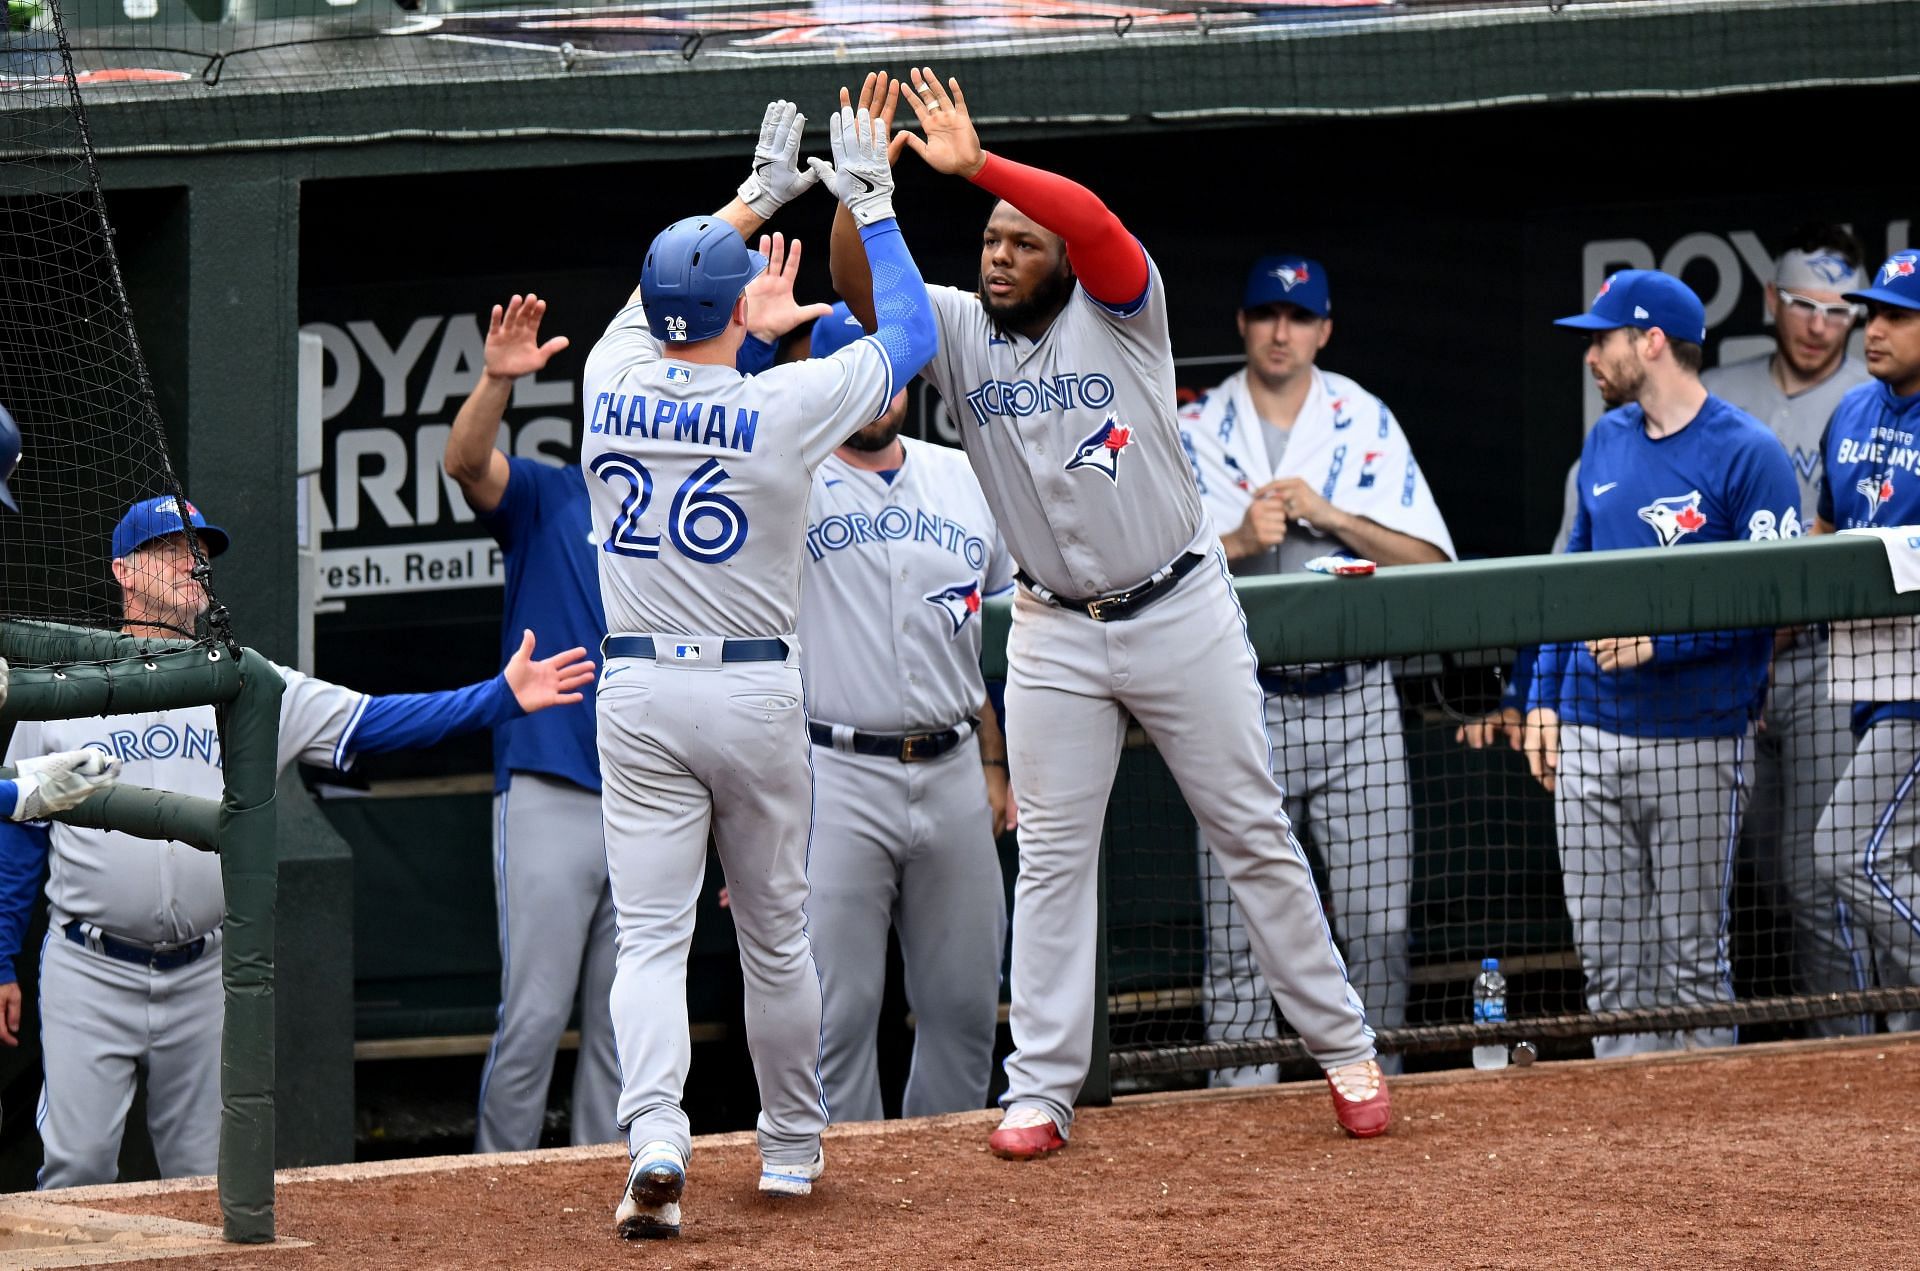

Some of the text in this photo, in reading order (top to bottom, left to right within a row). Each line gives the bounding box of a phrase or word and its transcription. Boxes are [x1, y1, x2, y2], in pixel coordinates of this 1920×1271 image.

[664, 315, 687, 331] 26
[590, 392, 759, 453] CHAPMAN
[966, 373, 1115, 427] TORONTO
[589, 452, 749, 564] 26
[1748, 506, 1802, 542] 86
[806, 506, 986, 571] TORONTO
[405, 549, 474, 583] Real
